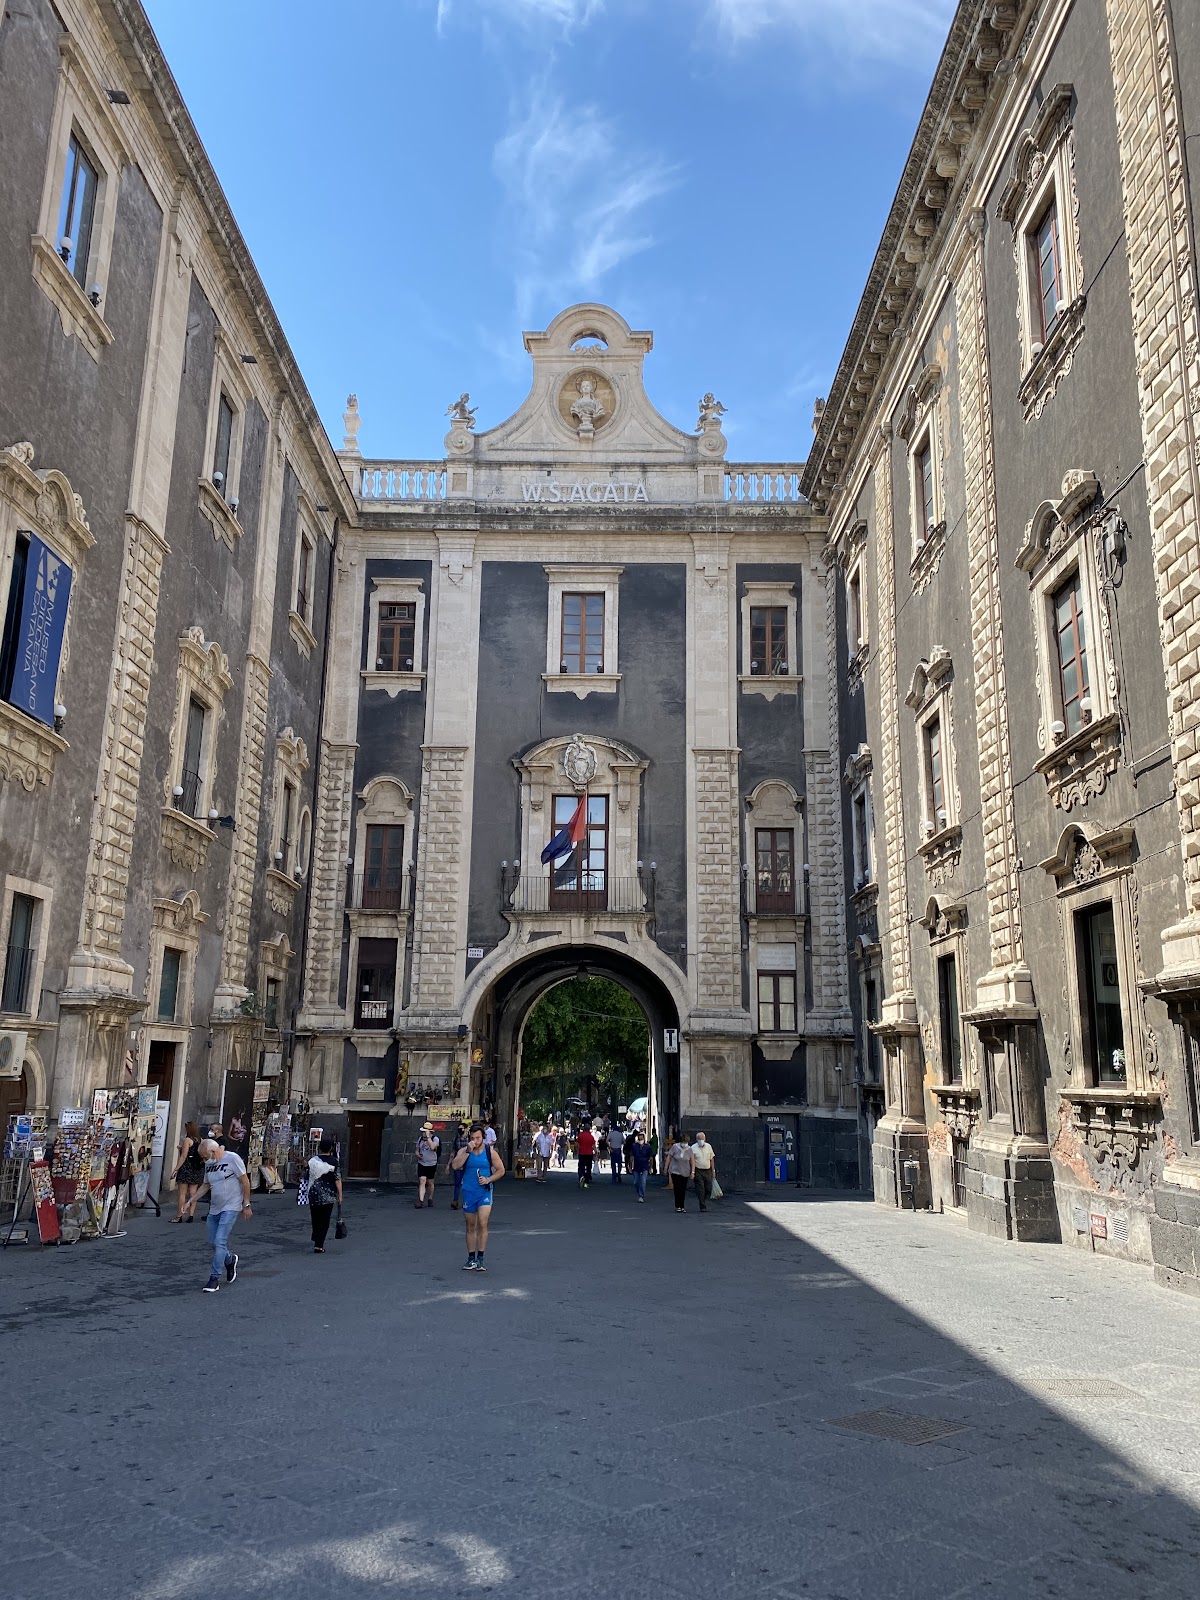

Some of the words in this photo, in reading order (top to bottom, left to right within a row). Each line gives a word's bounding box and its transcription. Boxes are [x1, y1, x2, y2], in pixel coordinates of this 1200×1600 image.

[23, 590, 41, 672] CATANIA
[28, 594, 47, 710] DIOCESANO
[39, 601, 54, 673] MUSEO
[785, 1130, 795, 1161] ATM
